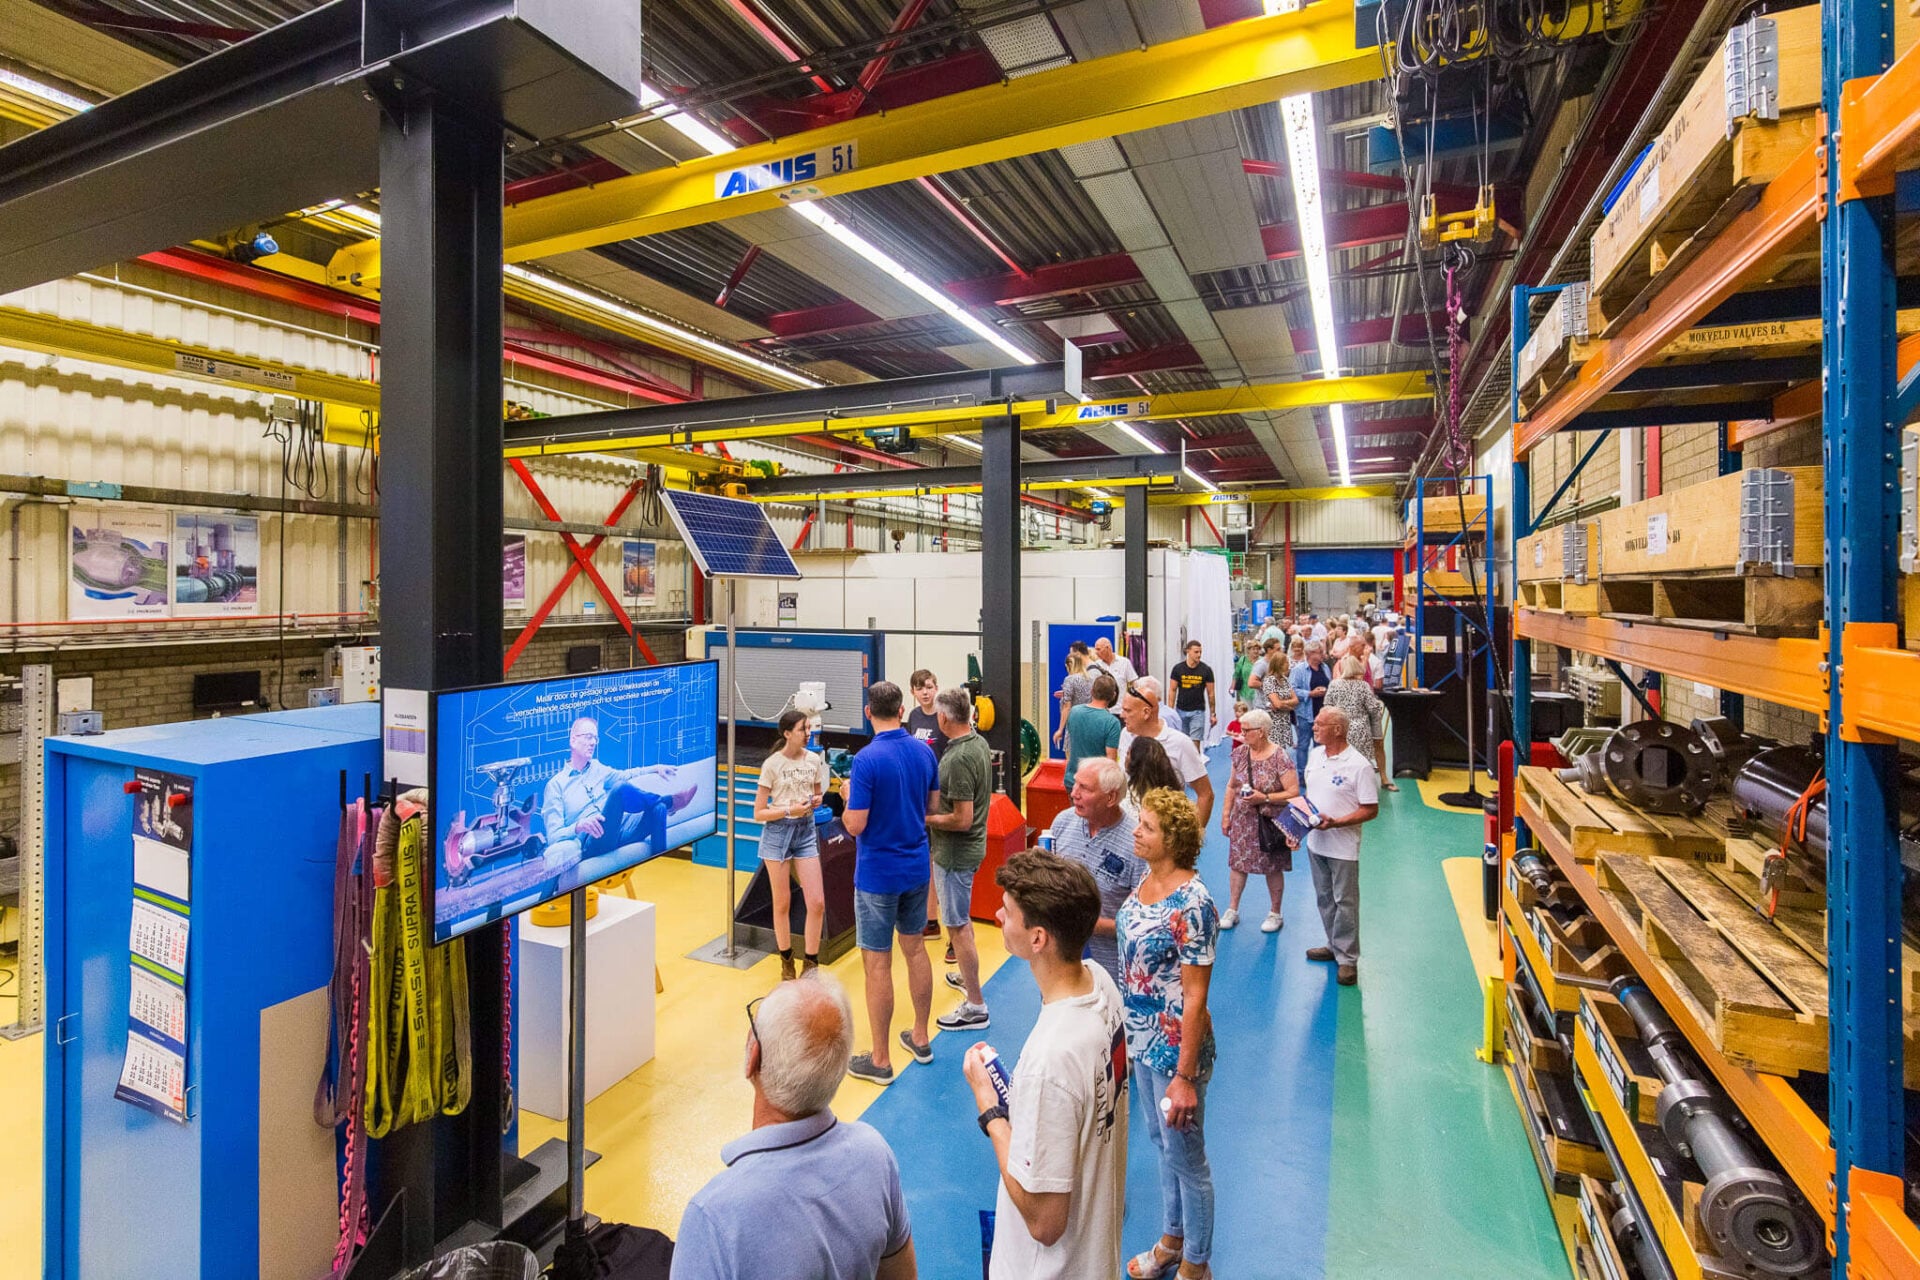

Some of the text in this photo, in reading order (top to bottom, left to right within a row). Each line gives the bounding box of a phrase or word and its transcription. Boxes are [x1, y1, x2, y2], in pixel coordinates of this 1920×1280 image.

[1689, 328, 1730, 343] MOKVELD
[1733, 326, 1768, 339] VALVES
[1079, 403, 1128, 419] ABUS
[1625, 535, 1649, 552] MOKVEL
[403, 844, 417, 889] PLUS
[404, 891, 420, 950] SUPRA
[1095, 1071, 1108, 1137] SINCE
